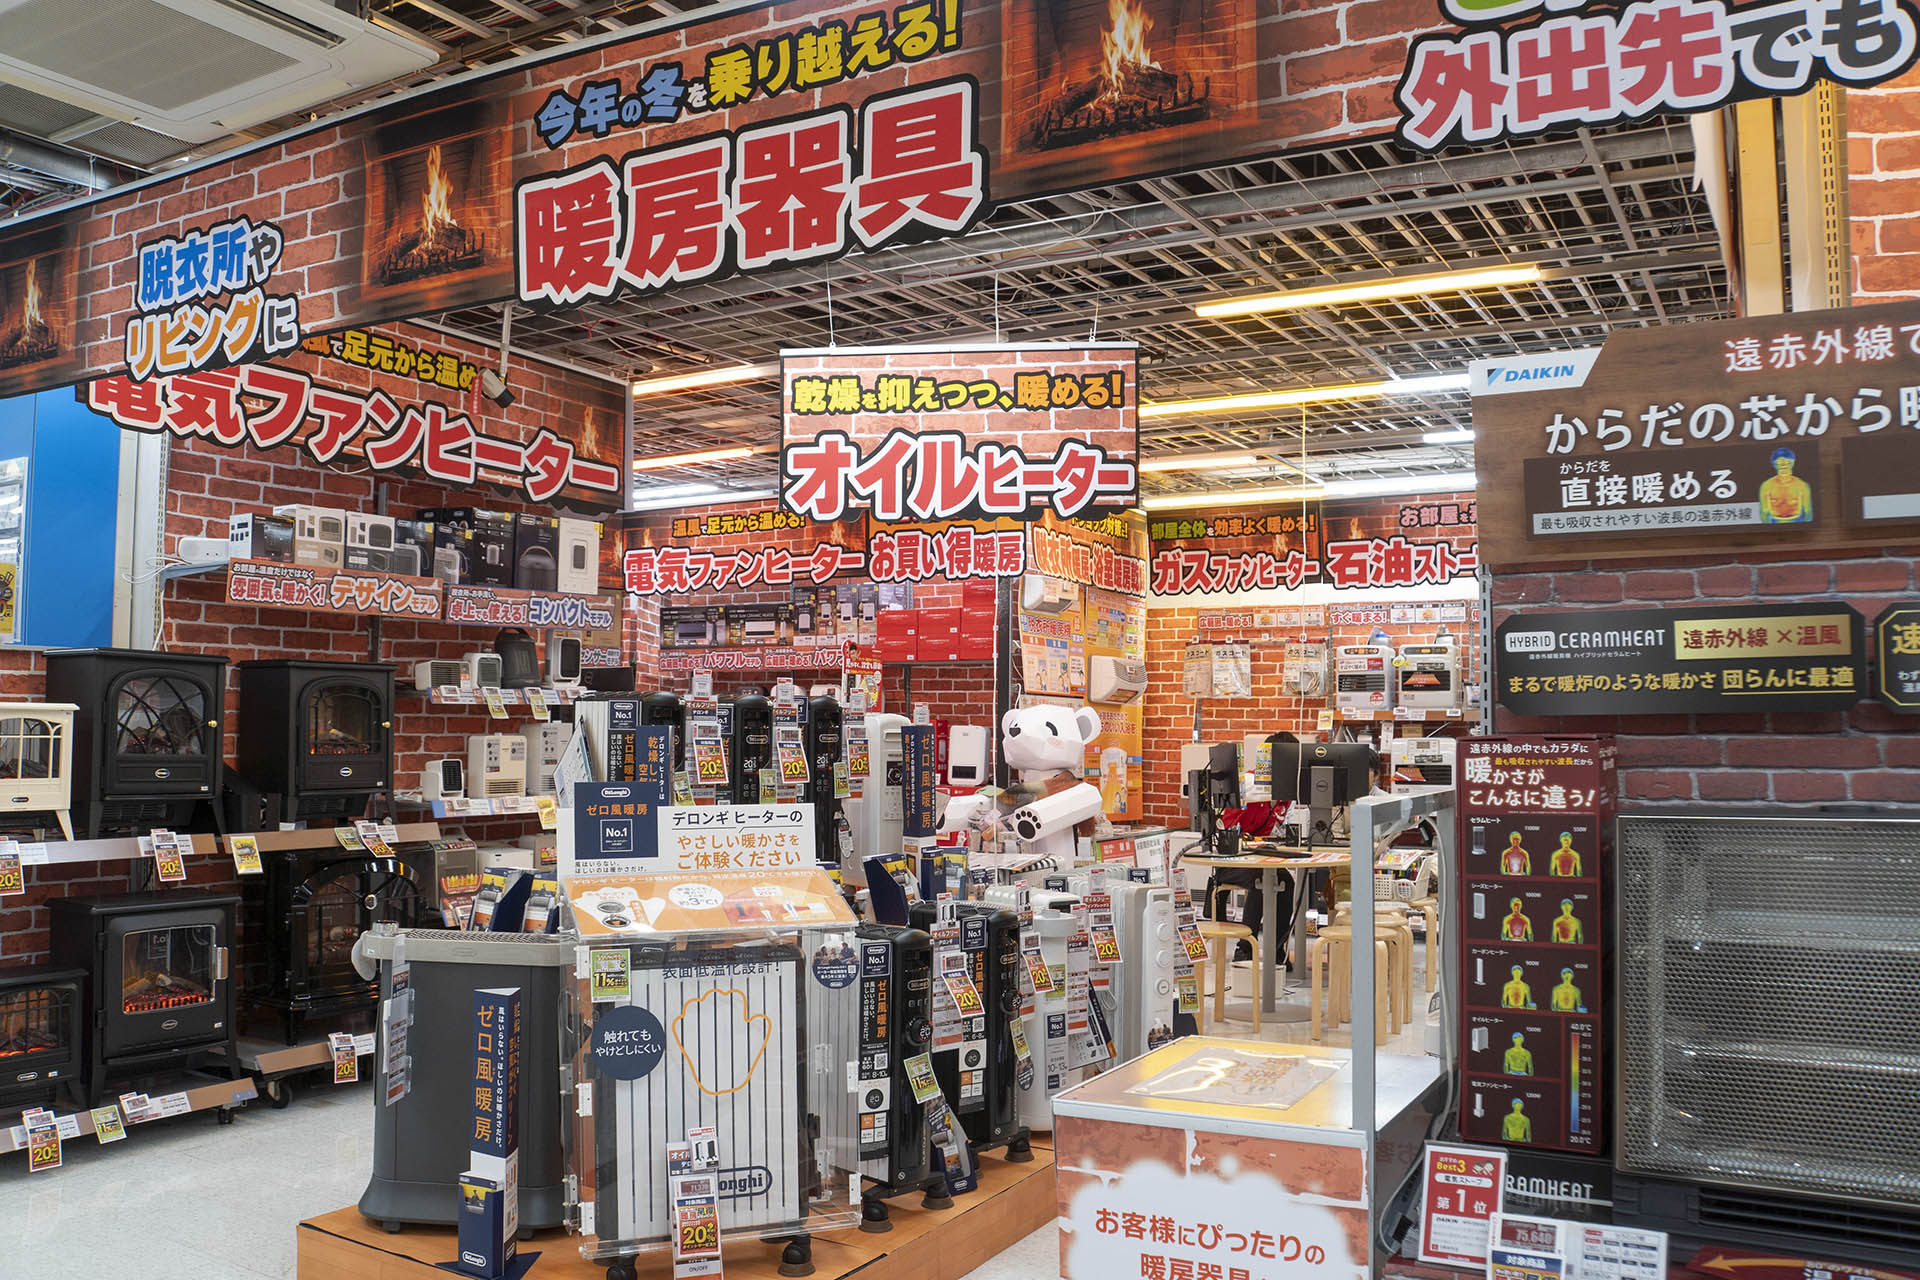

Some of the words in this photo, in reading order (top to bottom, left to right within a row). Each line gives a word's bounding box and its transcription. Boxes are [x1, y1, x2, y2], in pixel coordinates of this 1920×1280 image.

[538, 0, 961, 146] 今年の冬を乗り越える!
[1411, 0, 1903, 139] 外出先でも
[522, 88, 977, 296] 暖房器具
[141, 222, 278, 304] 脱衣所や
[129, 295, 298, 379] リビングに
[303, 331, 478, 390] 風で足元から温め
[1505, 363, 1574, 383] DAIKIN
[793, 374, 1124, 414] 乾燥を抑えつつ、暖める!
[791, 436, 1131, 515] オイルヒーター
[1559, 459, 1611, 475] からだを
[1560, 468, 1738, 508] 直接暖める
[1151, 515, 1315, 540] 部屋全体を効率よく暖める!
[1540, 507, 1752, 531] 最も吸収されやすい波長の遠赤外線
[871, 530, 1023, 579] お買い得暖房
[1329, 540, 1477, 587] 石油ストー
[626, 547, 863, 592] 電気ファンヒーター
[1154, 550, 1319, 593] ガスファンヒーター
[232, 576, 326, 605] 雰囲気も暖かく!
[451, 598, 527, 622] 卓上でも使える!
[1509, 634, 1551, 648] HYBRID
[1559, 629, 1666, 648] CERAMHEAT
[1508, 671, 1718, 694] まるで暖炉のような暖かさ
[1722, 666, 1856, 689] 団らんに最適
[615, 711, 632, 719] No.1
[1470, 743, 1589, 754] 遠赤外線の中でもカラダに
[1464, 757, 1545, 785] 暖かさが
[586, 803, 649, 816] ゼロ風暖房
[1469, 785, 1596, 809] こんなに違う!
[673, 810, 729, 826] デロンギ
[735, 810, 803, 825] ヒーターの
[605, 827, 628, 838] No.1
[677, 832, 800, 850] やさしい暖かさを
[678, 850, 801, 870] ご体験ください
[967, 930, 982, 938] No.1
[868, 956, 885, 964] No.1
[603, 1029, 652, 1044] 触れても
[596, 1043, 661, 1057] やけどしにくい
[474, 1004, 494, 1142] ゼロ風暖房
[719, 1173, 763, 1192] onghi
[1506, 1174, 1594, 1200] RAMHEAT
[1095, 1207, 1326, 1265] お客様にぴったりの
